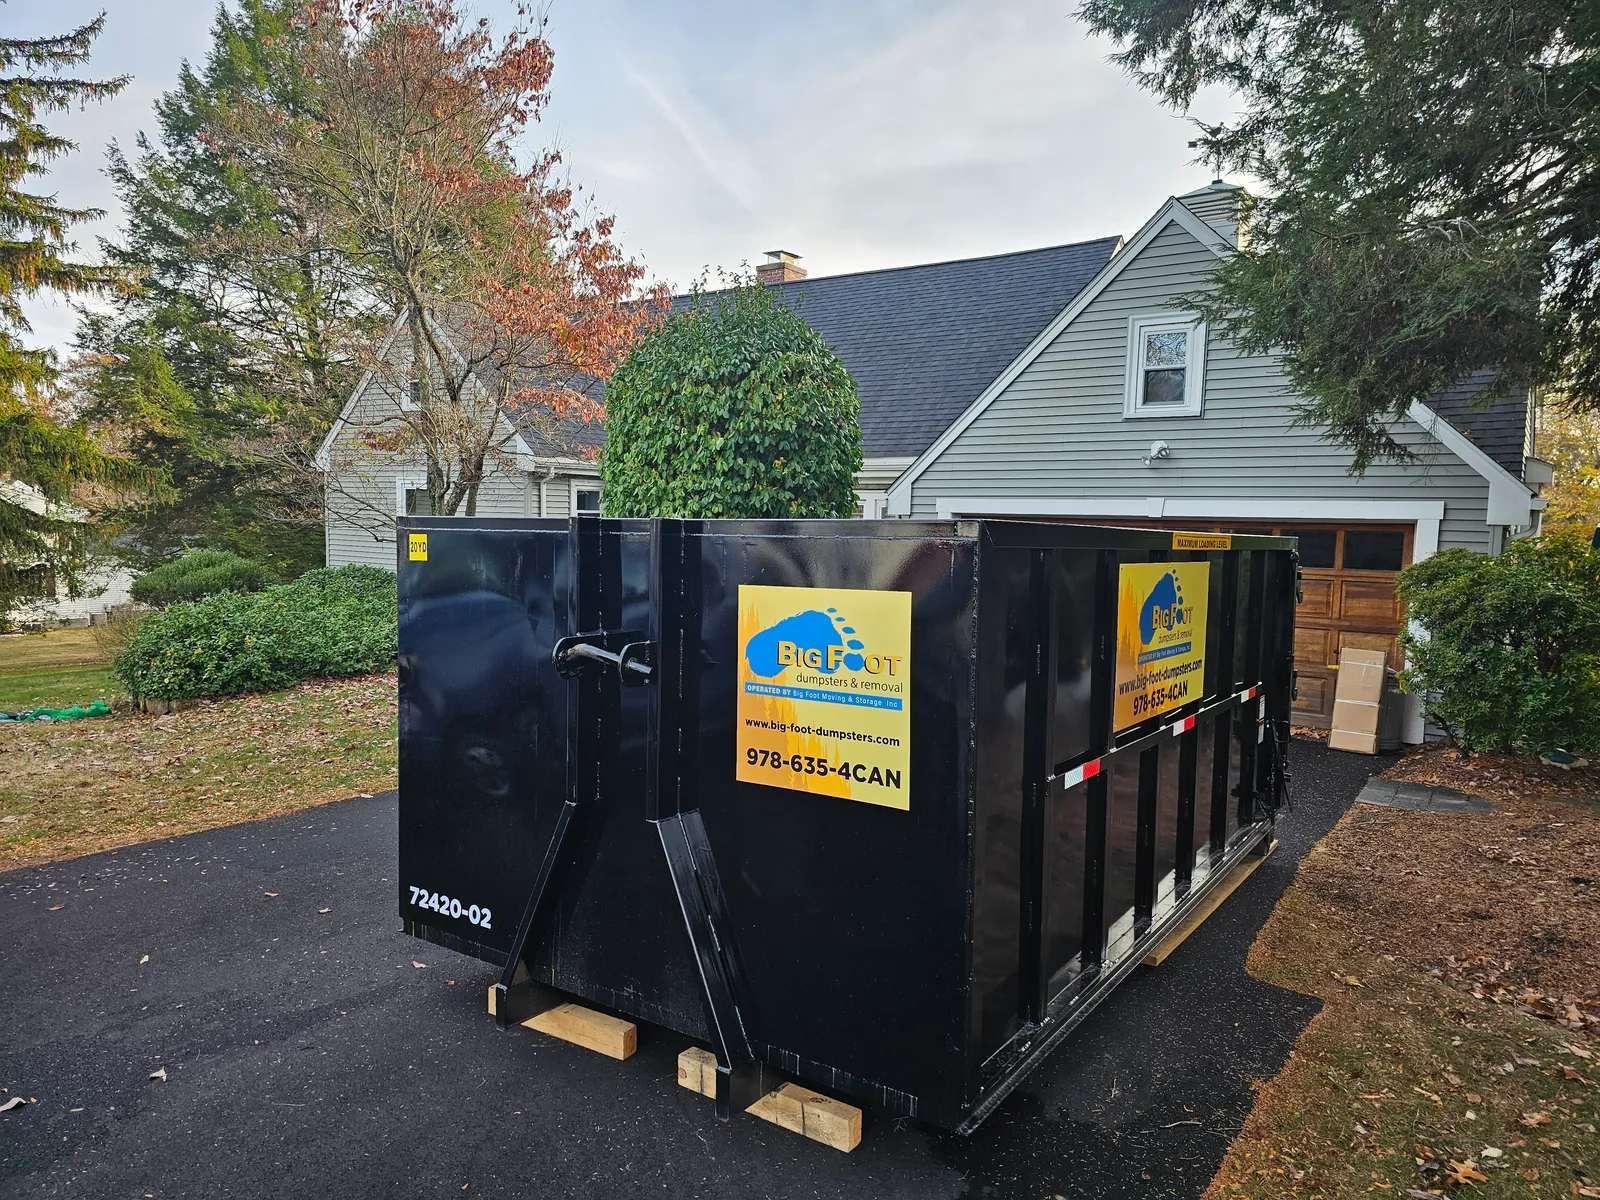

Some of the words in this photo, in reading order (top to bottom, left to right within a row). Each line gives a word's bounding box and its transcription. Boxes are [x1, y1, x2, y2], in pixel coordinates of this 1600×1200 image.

[1177, 538, 1198, 548] MAXIMUM
[1198, 540, 1216, 548] LOADING
[1216, 540, 1228, 549] LEVEL
[796, 672, 848, 688] dumpsters
[850, 677, 858, 688] &
[861, 681, 903, 693] removal
[1118, 659, 1203, 695] www.big-foot-dumpsters.com
[747, 684, 781, 695] OPERATED
[782, 688, 791, 696] BY
[793, 689, 804, 699] Big
[805, 691, 820, 699] Foot
[822, 692, 846, 703] Moving
[1133, 680, 1189, 716] 978-635-4CAN
[745, 718, 900, 747] www.big-foot-dumpsters.com
[746, 748, 901, 789] 978-635-4CAN
[409, 885, 492, 930] 72420-02
